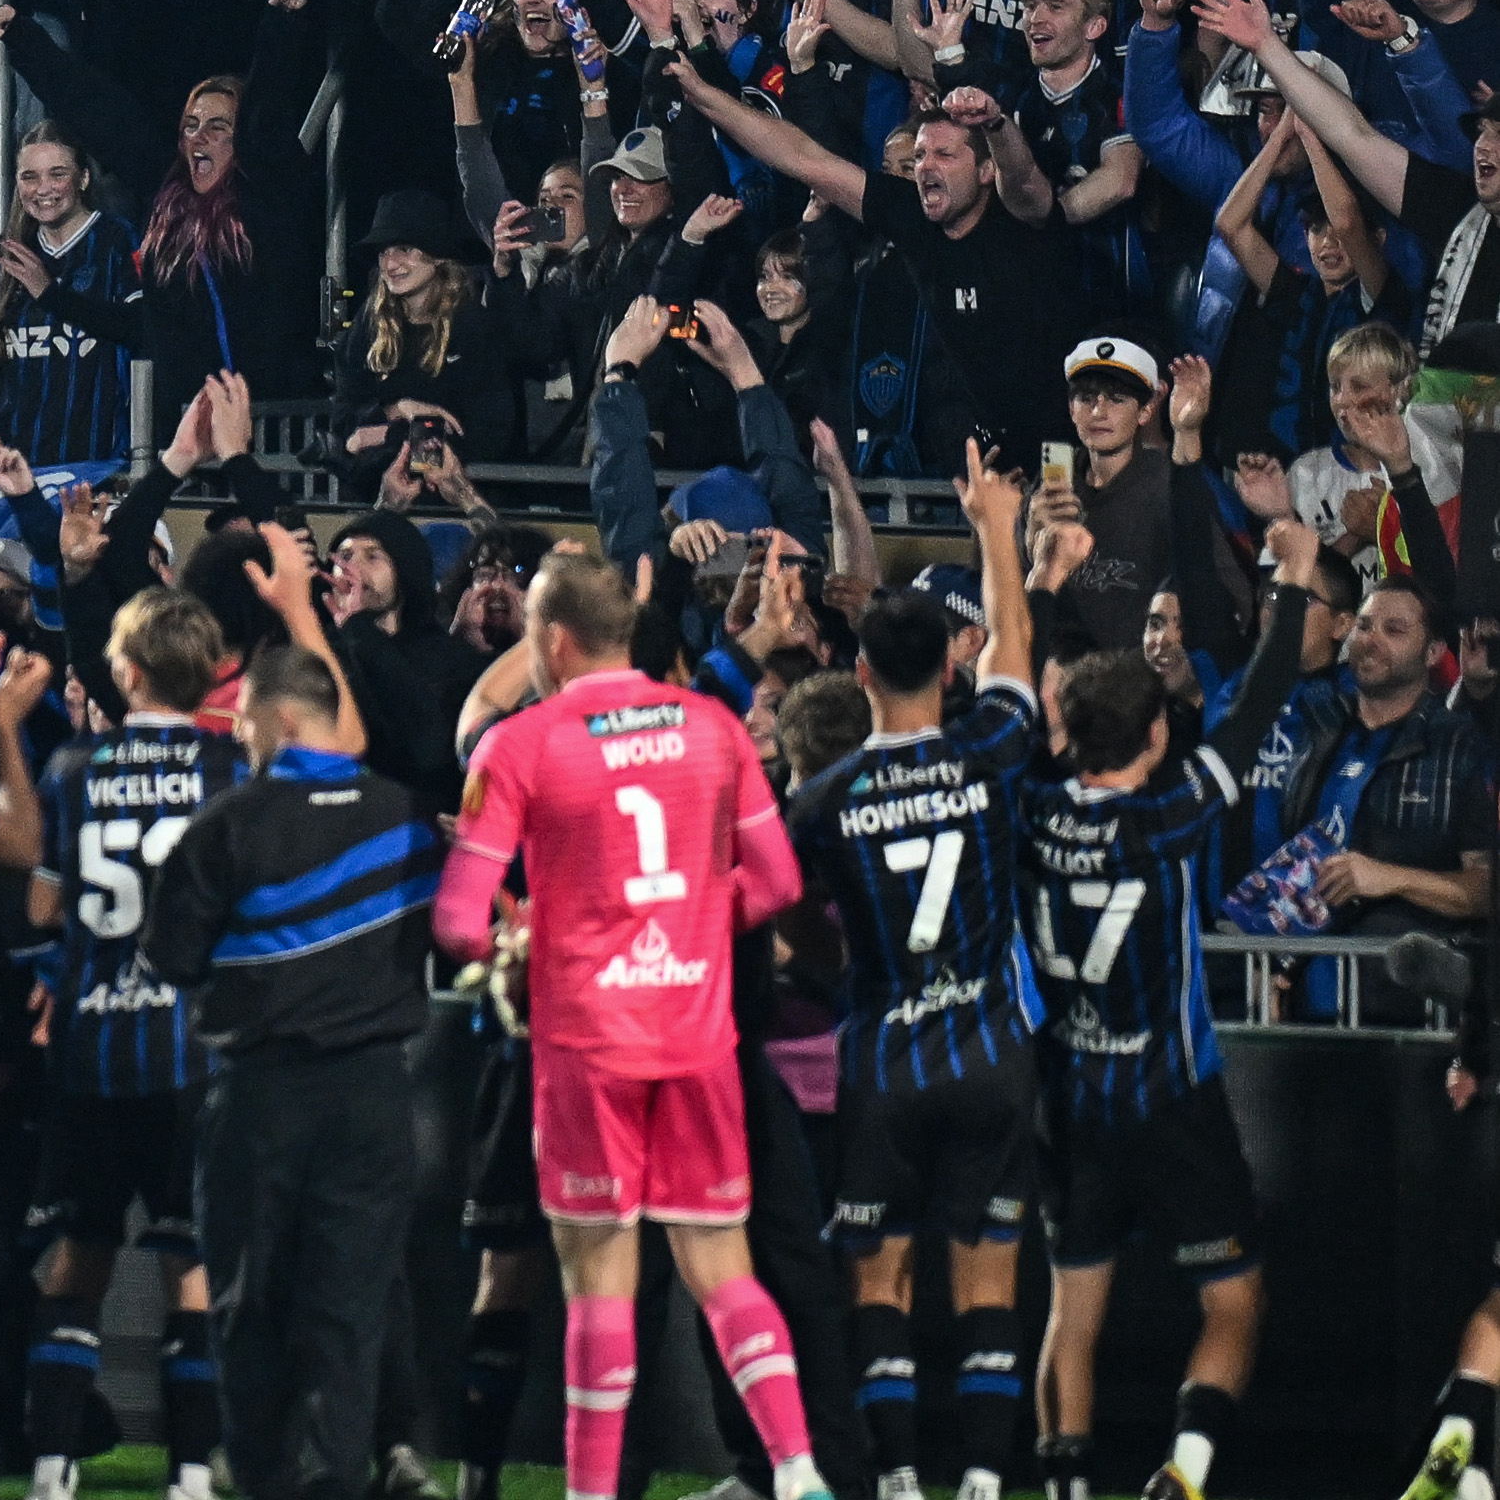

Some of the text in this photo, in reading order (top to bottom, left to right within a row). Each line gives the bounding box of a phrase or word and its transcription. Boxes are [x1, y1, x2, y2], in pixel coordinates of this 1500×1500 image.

[601, 732, 687, 770] WOUD
[87, 772, 204, 809] VICELICH
[874, 760, 966, 793] Liberty
[838, 783, 991, 839] HOWIESON
[615, 785, 689, 907] 1
[882, 830, 966, 954] 7
